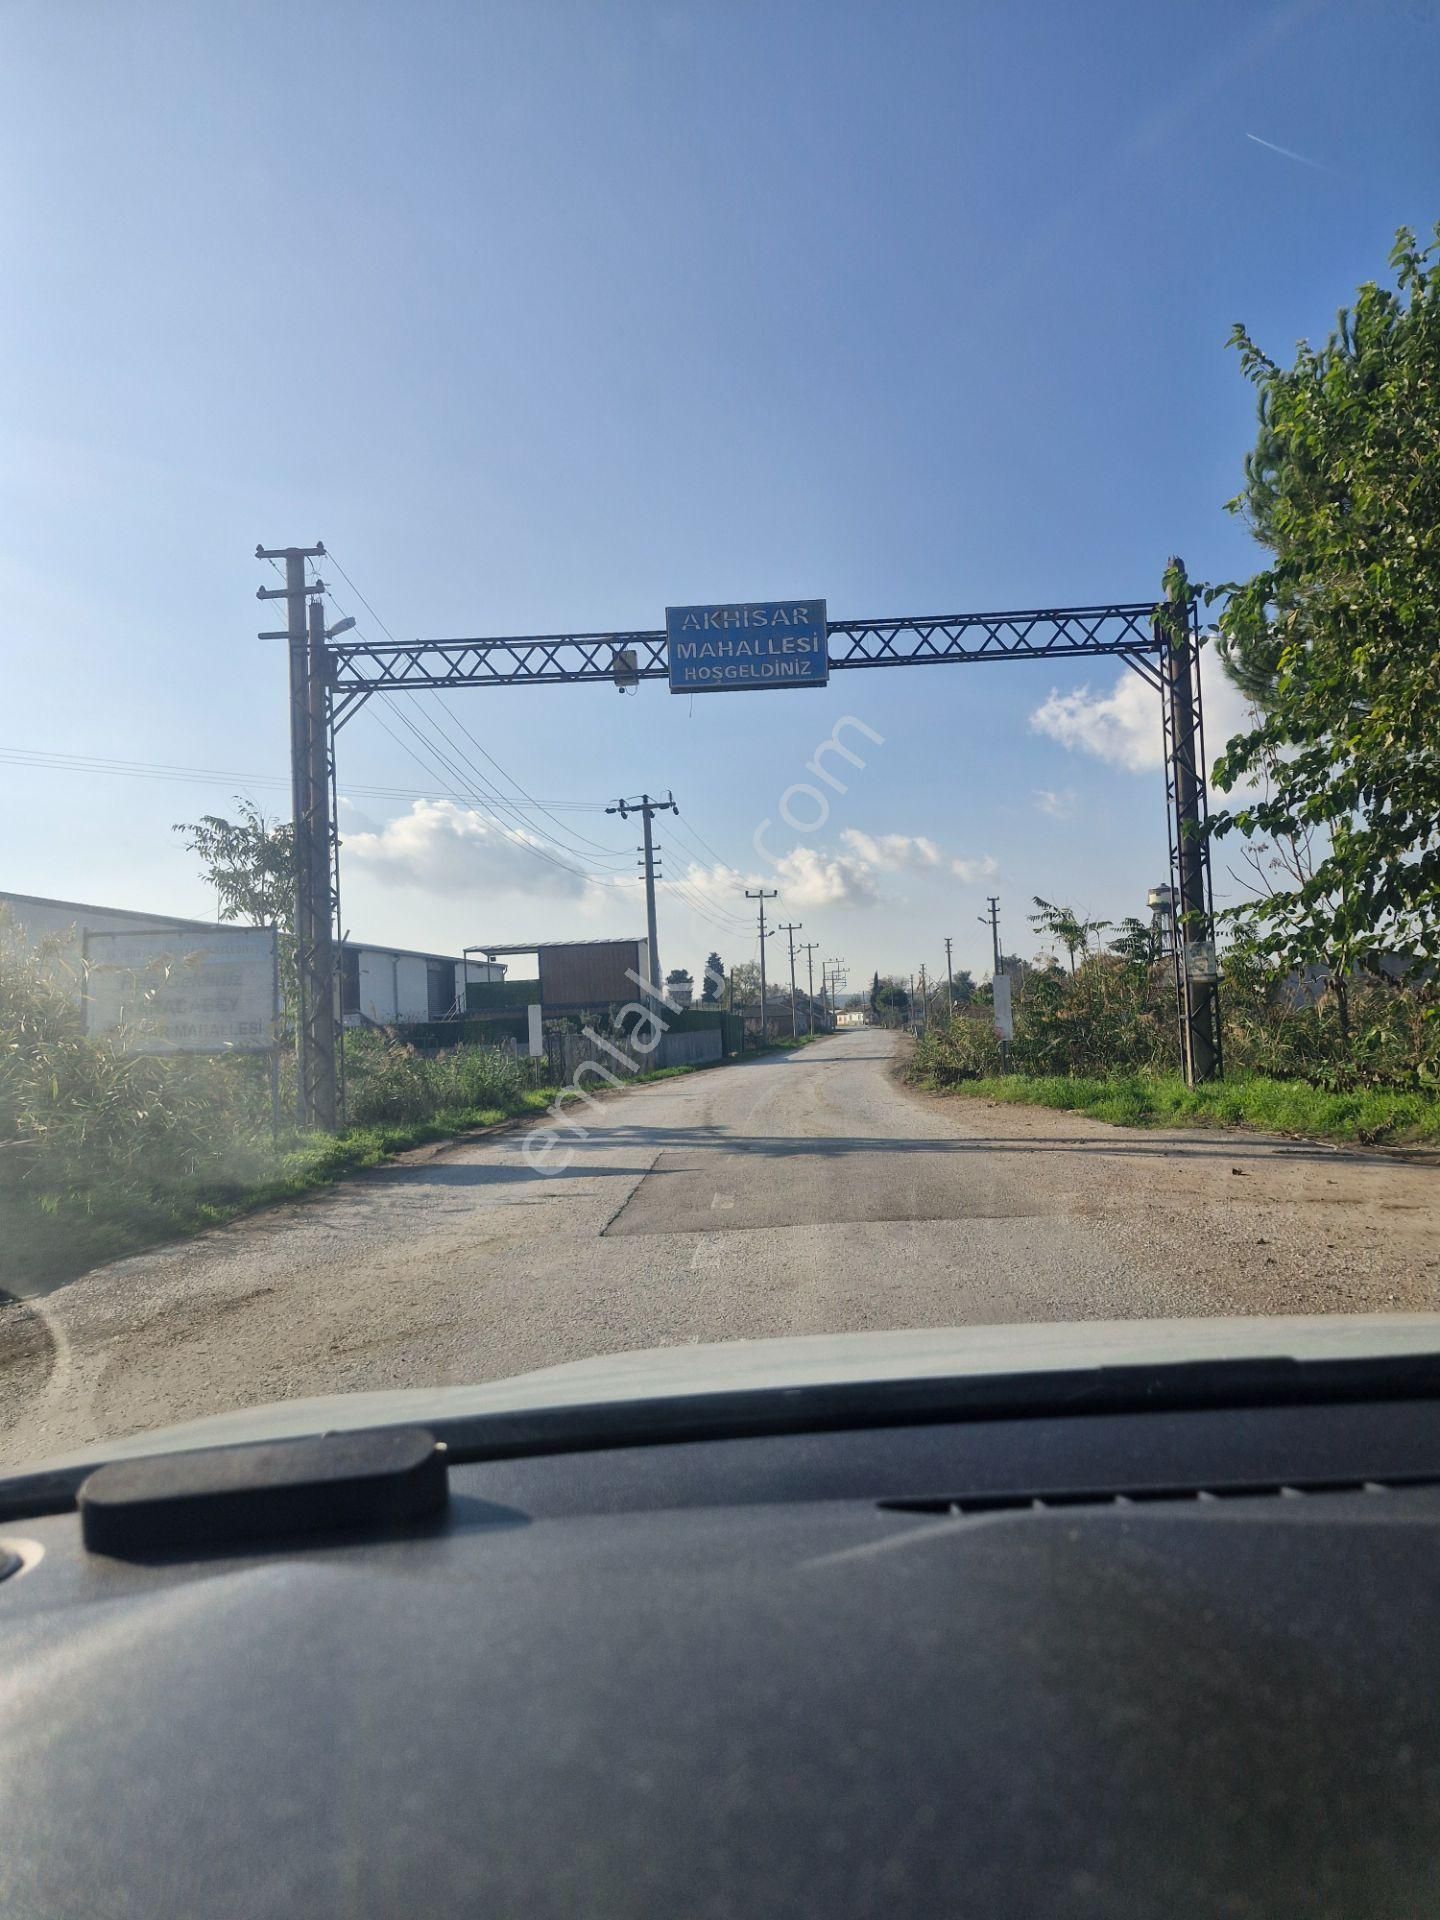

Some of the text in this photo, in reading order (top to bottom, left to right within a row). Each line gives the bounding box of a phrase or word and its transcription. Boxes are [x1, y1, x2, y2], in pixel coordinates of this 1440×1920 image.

[681, 606, 810, 631] AKHİSAR
[677, 632, 819, 659] MAHALLESİ
[684, 659, 812, 684] HOŞGELDİNİZ
